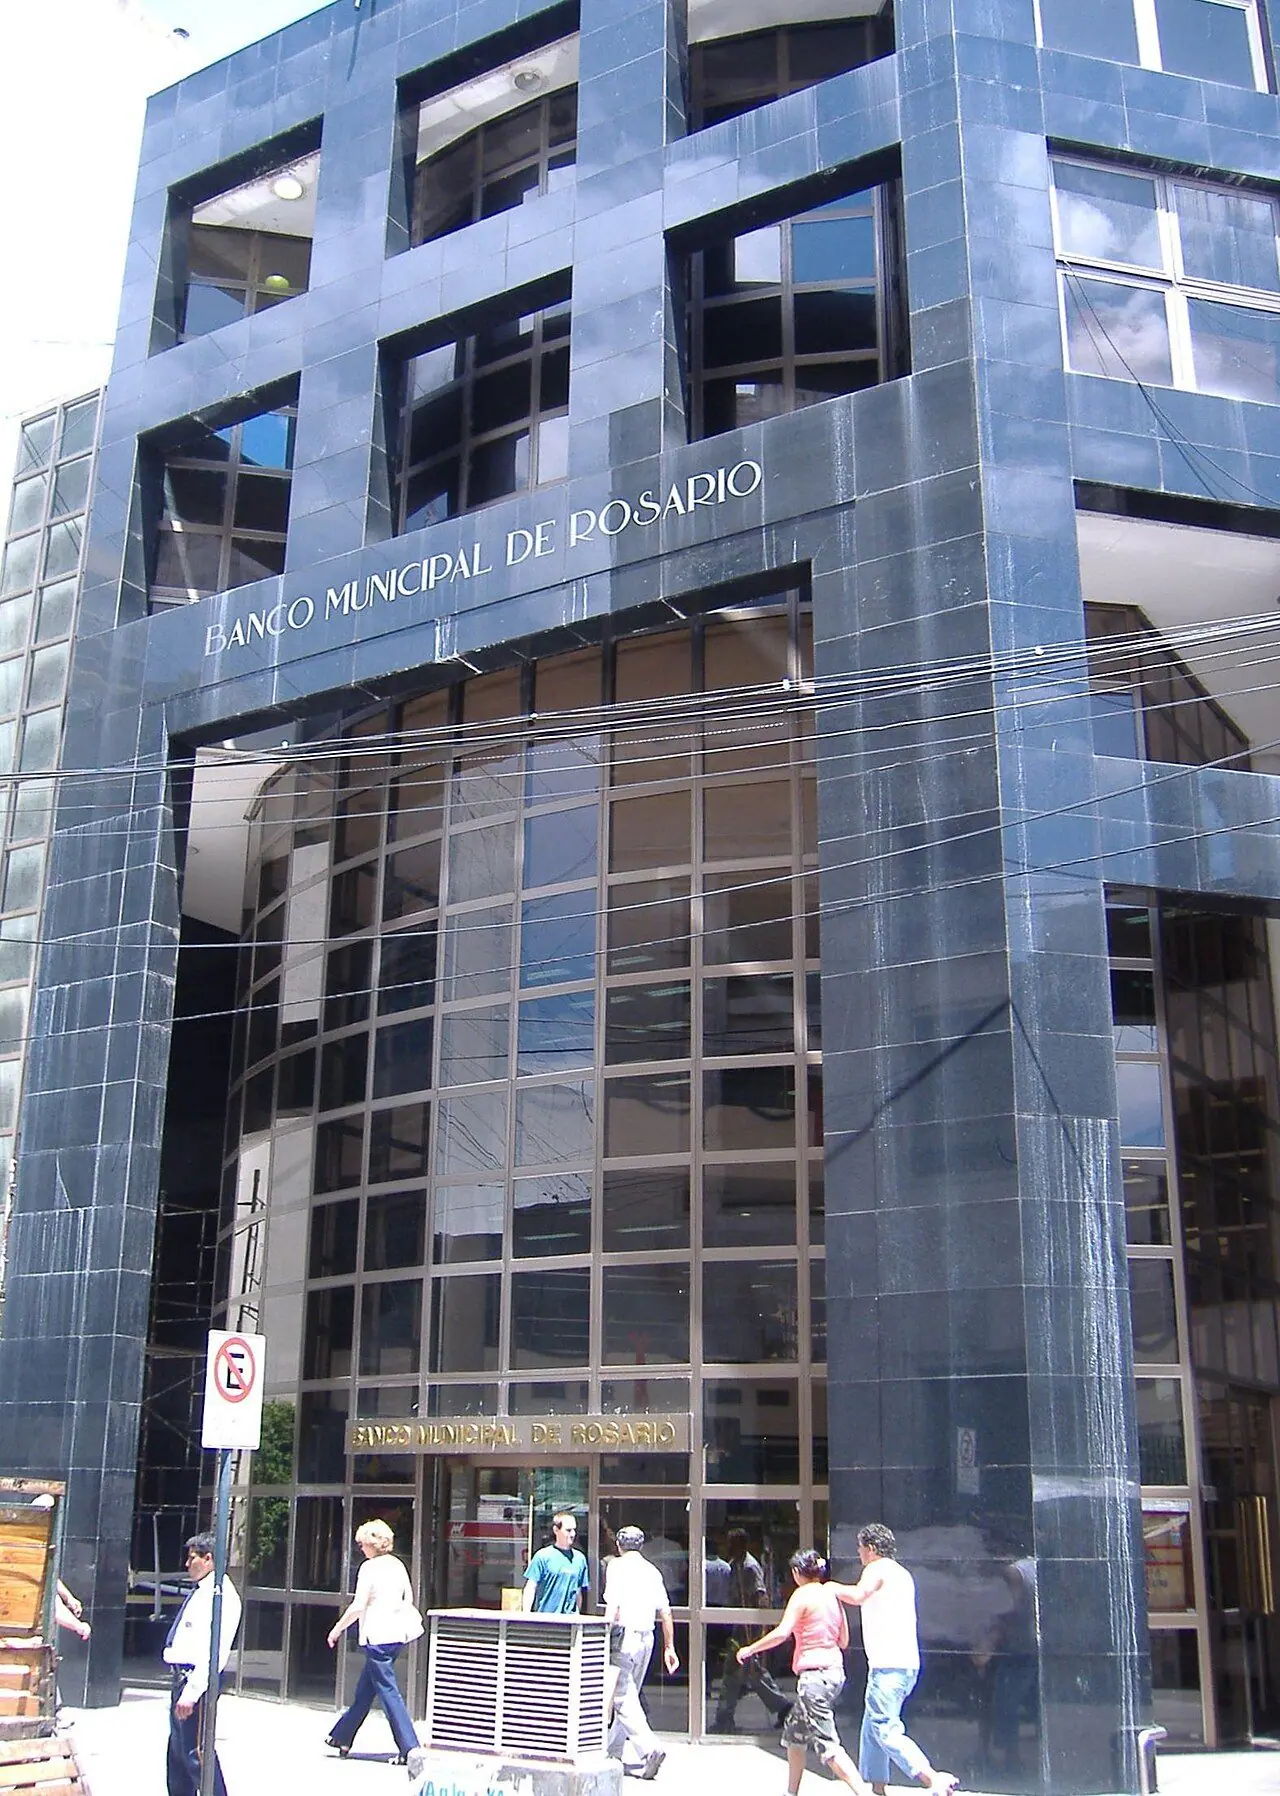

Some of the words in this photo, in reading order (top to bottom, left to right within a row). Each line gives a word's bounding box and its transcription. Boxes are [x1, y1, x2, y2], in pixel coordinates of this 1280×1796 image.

[205, 597, 315, 657] BANCO
[325, 543, 493, 620] MUNICIPAL
[506, 519, 556, 566] DE
[569, 460, 762, 547] ROSARIO
[227, 1353, 245, 1389] E
[352, 1424, 412, 1448] BANCO
[416, 1423, 522, 1446] MUNICIPAL
[531, 1422, 562, 1445] DE
[571, 1420, 676, 1446] ROSARIO
